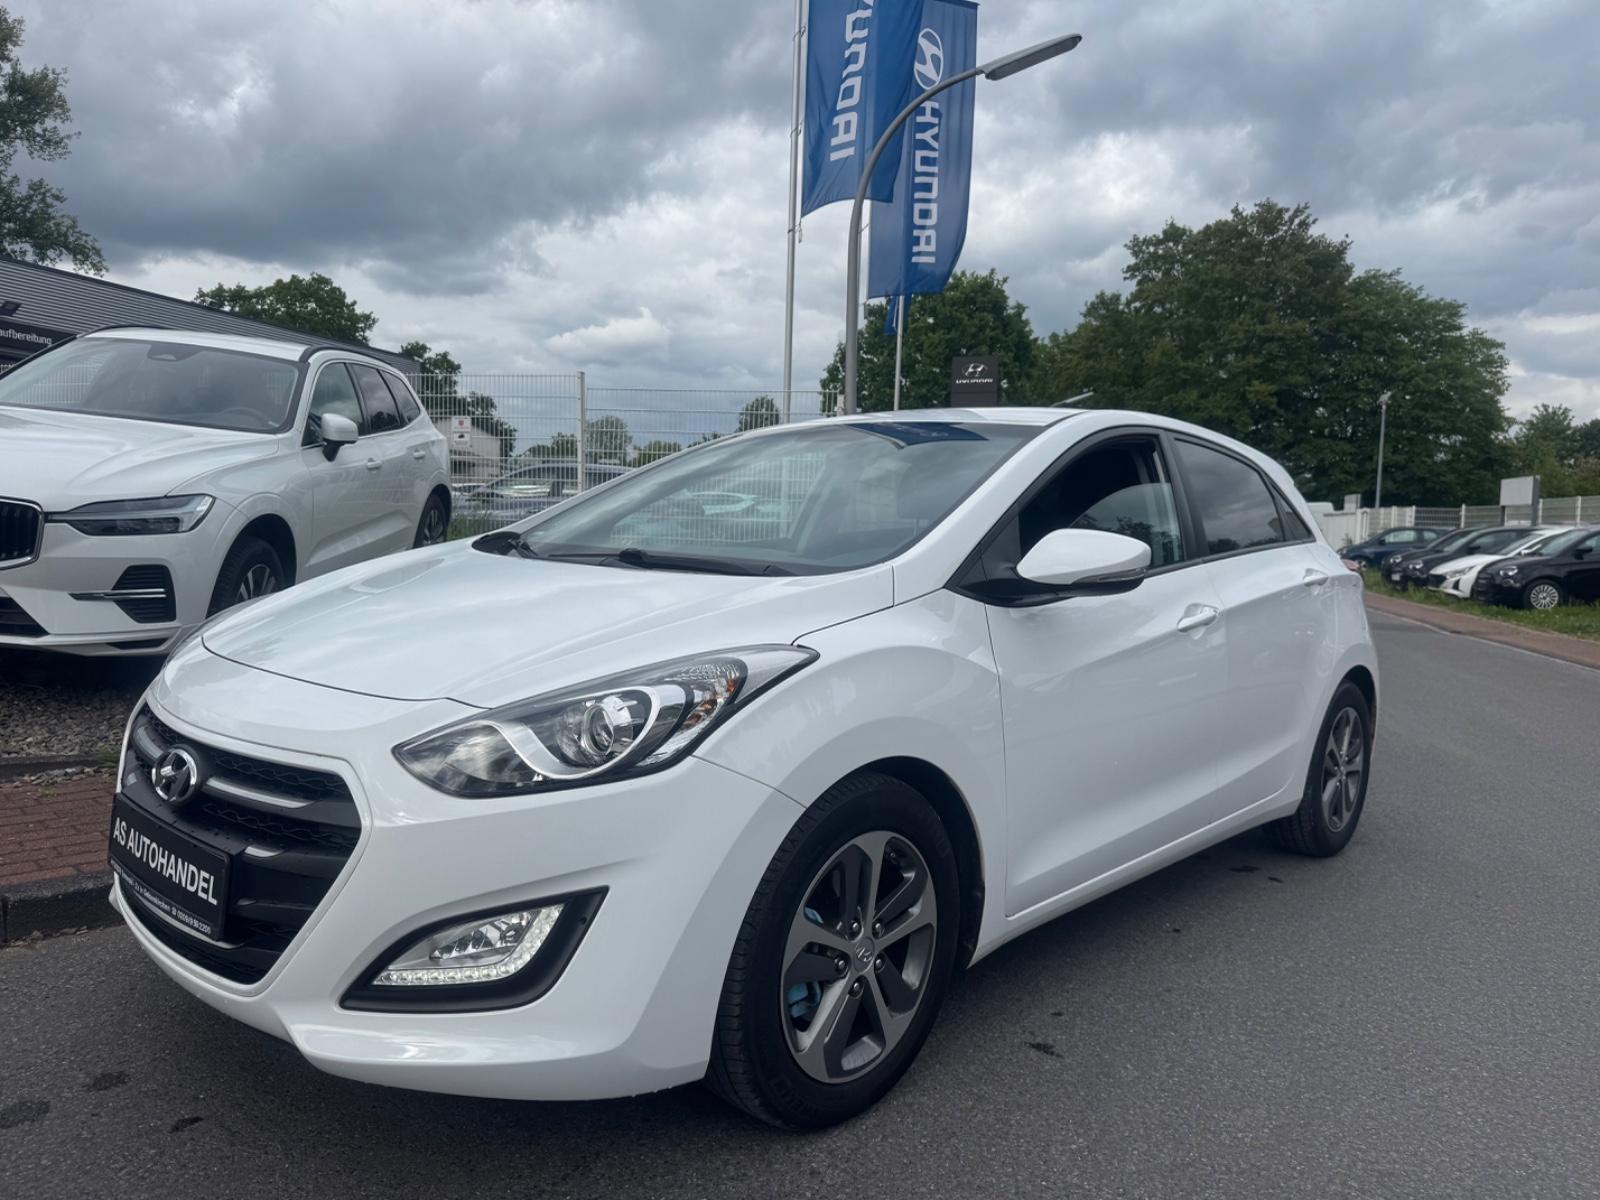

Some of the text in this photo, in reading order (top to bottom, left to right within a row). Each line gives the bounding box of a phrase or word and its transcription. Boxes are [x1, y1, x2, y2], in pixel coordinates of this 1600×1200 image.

[911, 100, 939, 263] HYUNDAI
[113, 817, 127, 846] AS
[127, 828, 218, 906] AUTOHANDEL
